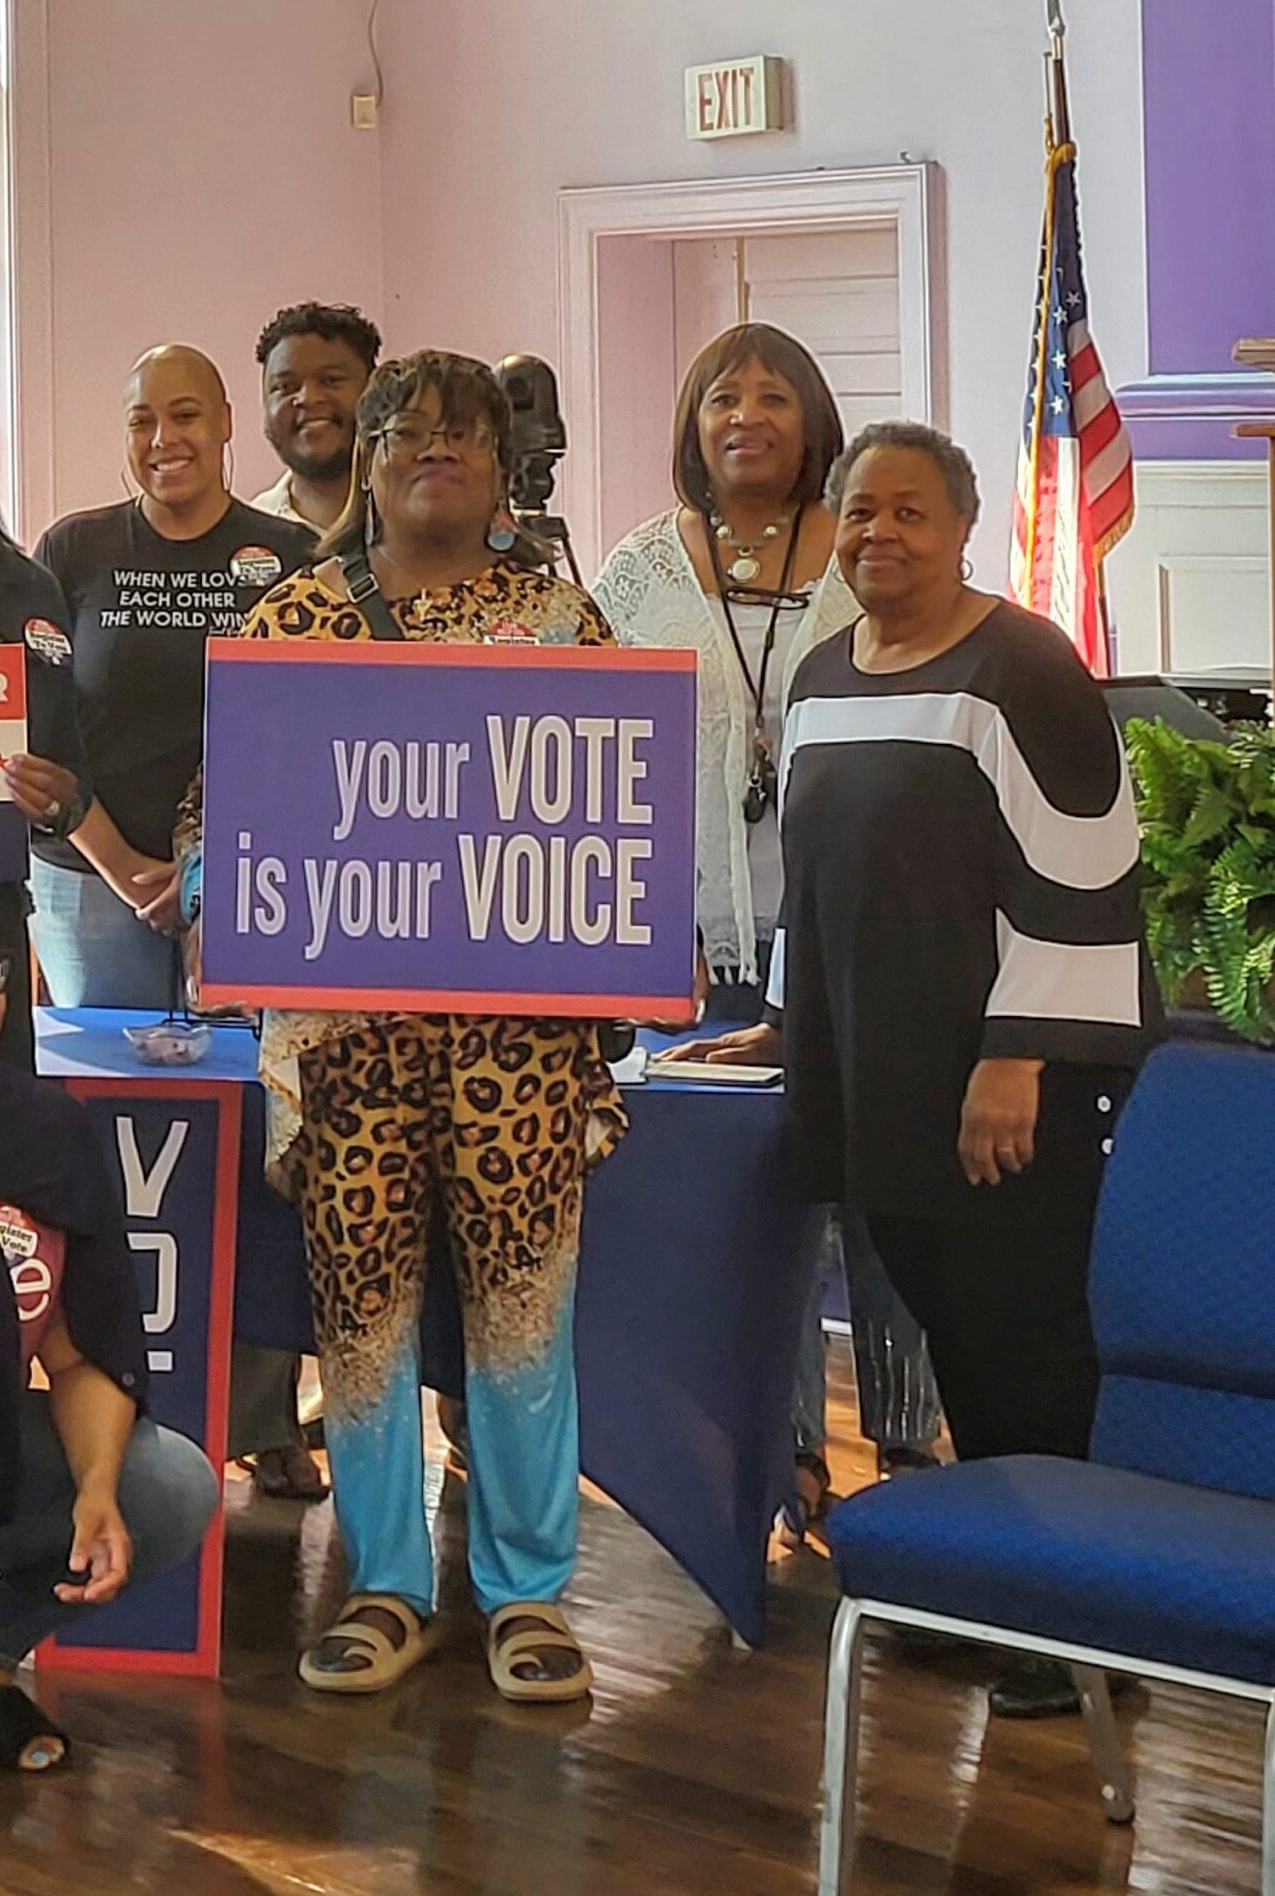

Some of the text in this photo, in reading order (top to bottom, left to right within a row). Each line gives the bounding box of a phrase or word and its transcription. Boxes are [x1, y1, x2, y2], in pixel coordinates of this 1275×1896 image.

[698, 67, 754, 132] EXIT
[113, 570, 166, 587] WHEN
[170, 572, 198, 588] WE
[119, 591, 236, 608] EACH OTHER
[100, 611, 132, 628] THE
[136, 611, 207, 627] WORLD
[333, 715, 654, 840] your VOTE
[236, 831, 653, 960] is your VOICE
